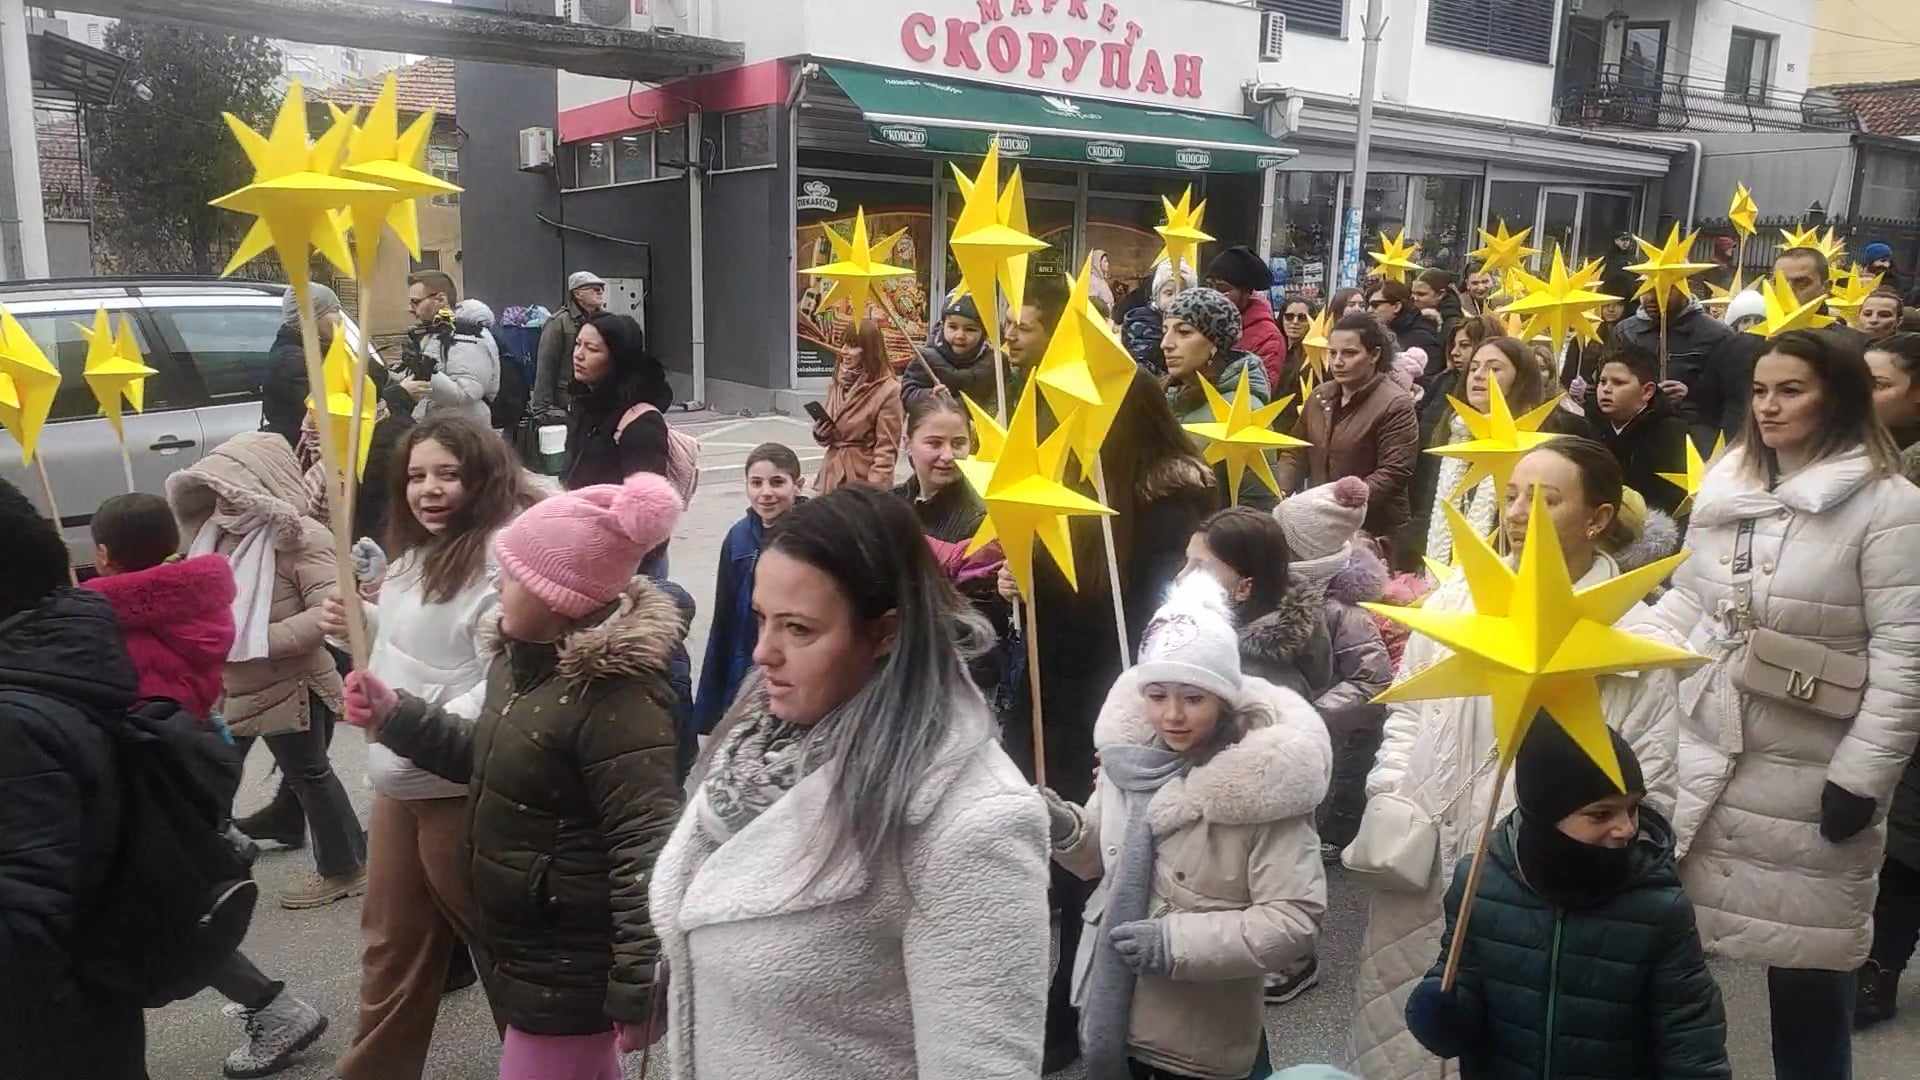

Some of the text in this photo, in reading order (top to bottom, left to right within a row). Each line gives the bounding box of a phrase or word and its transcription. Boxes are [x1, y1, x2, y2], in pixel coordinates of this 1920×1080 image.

[901, 12, 1203, 97] СКОРУПАН
[990, 137, 1029, 151] ОПСКО
[1087, 144, 1123, 158] СКОПСКО
